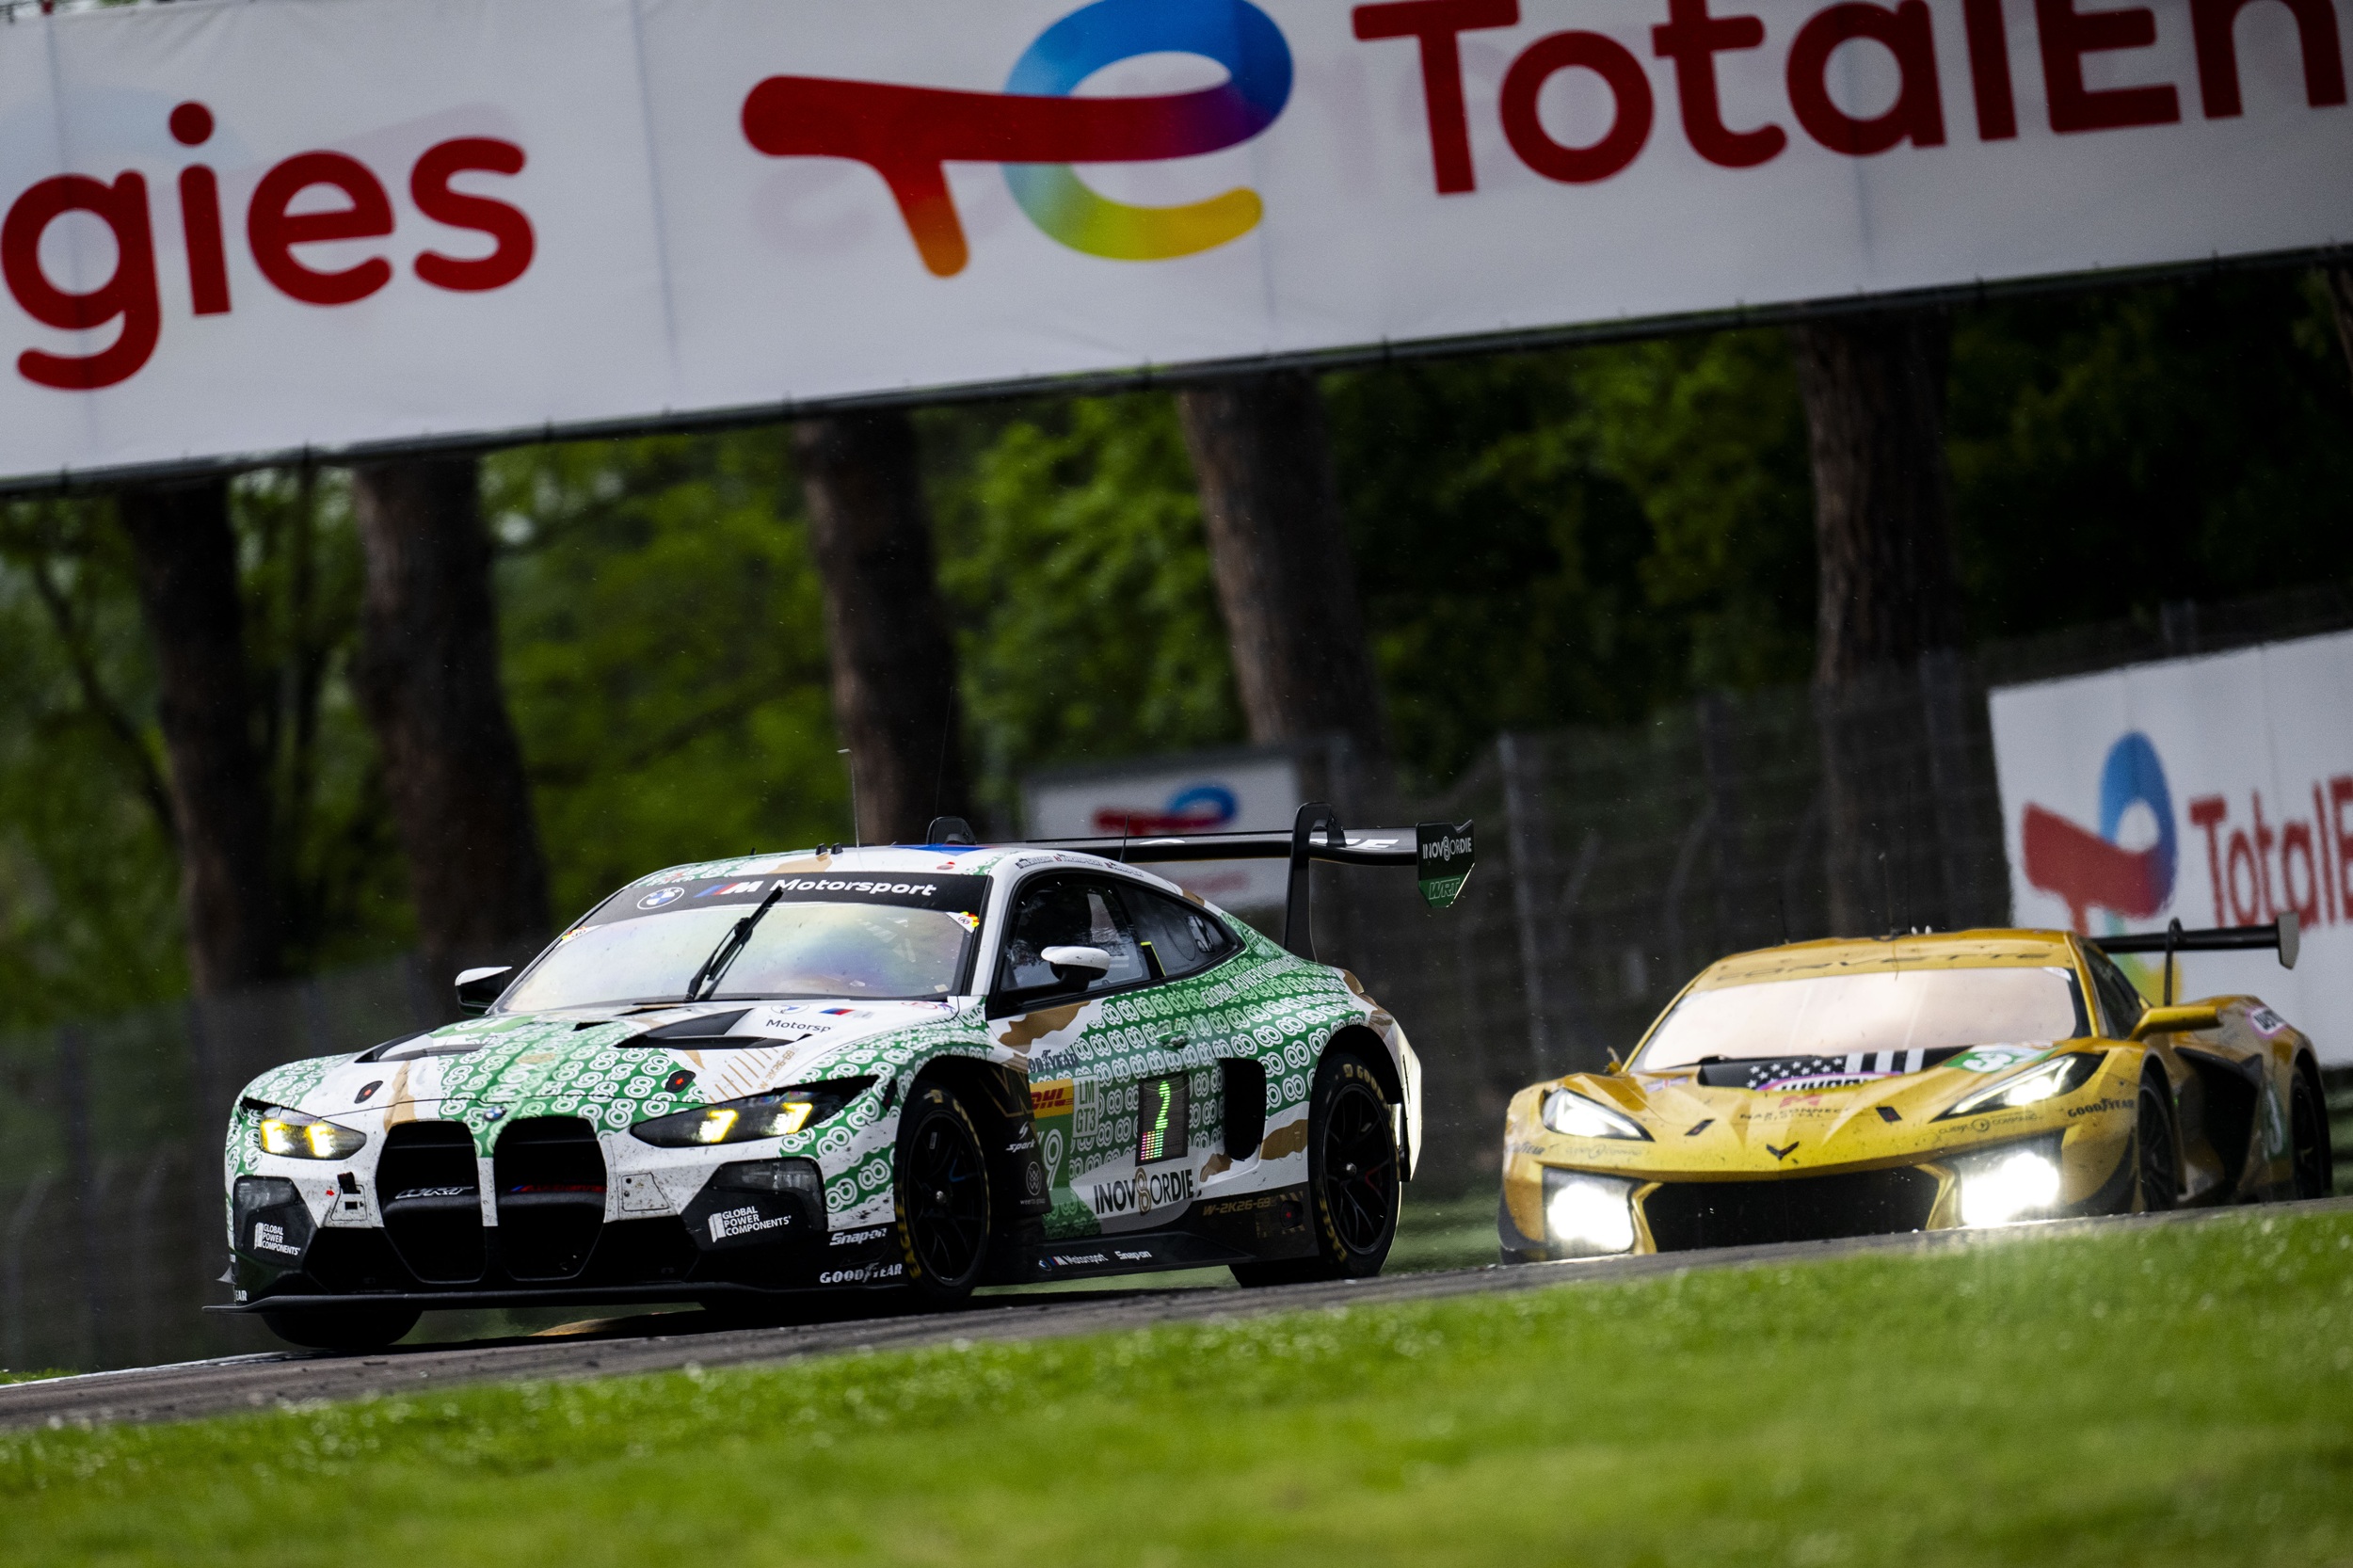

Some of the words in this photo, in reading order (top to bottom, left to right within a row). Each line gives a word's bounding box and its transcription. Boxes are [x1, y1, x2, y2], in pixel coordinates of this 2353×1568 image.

[1352, 0, 2348, 195] TotalEn
[0, 101, 536, 391] gies
[769, 878, 937, 897] Motorsport
[1201, 981, 1240, 1008] GLOBAL
[1229, 968, 1267, 990] POWER
[1028, 1049, 1080, 1074] ODYEAR
[1031, 1088, 1066, 1111] DHL
[1079, 1079, 1095, 1105] LM
[2067, 1097, 2135, 1118] GOODYEAR
[1076, 1107, 1096, 1134] GT3
[1005, 1139, 1036, 1153] spark
[1094, 1167, 1193, 1216] INOV8ORDIE
[722, 1206, 758, 1221] GLOBAL
[1203, 1197, 1272, 1217] W-2K26-69
[264, 1224, 284, 1235] GLOBAL
[724, 1214, 760, 1228] POWER
[263, 1233, 283, 1243] POWER
[819, 1262, 904, 1284] GOODYEAR
